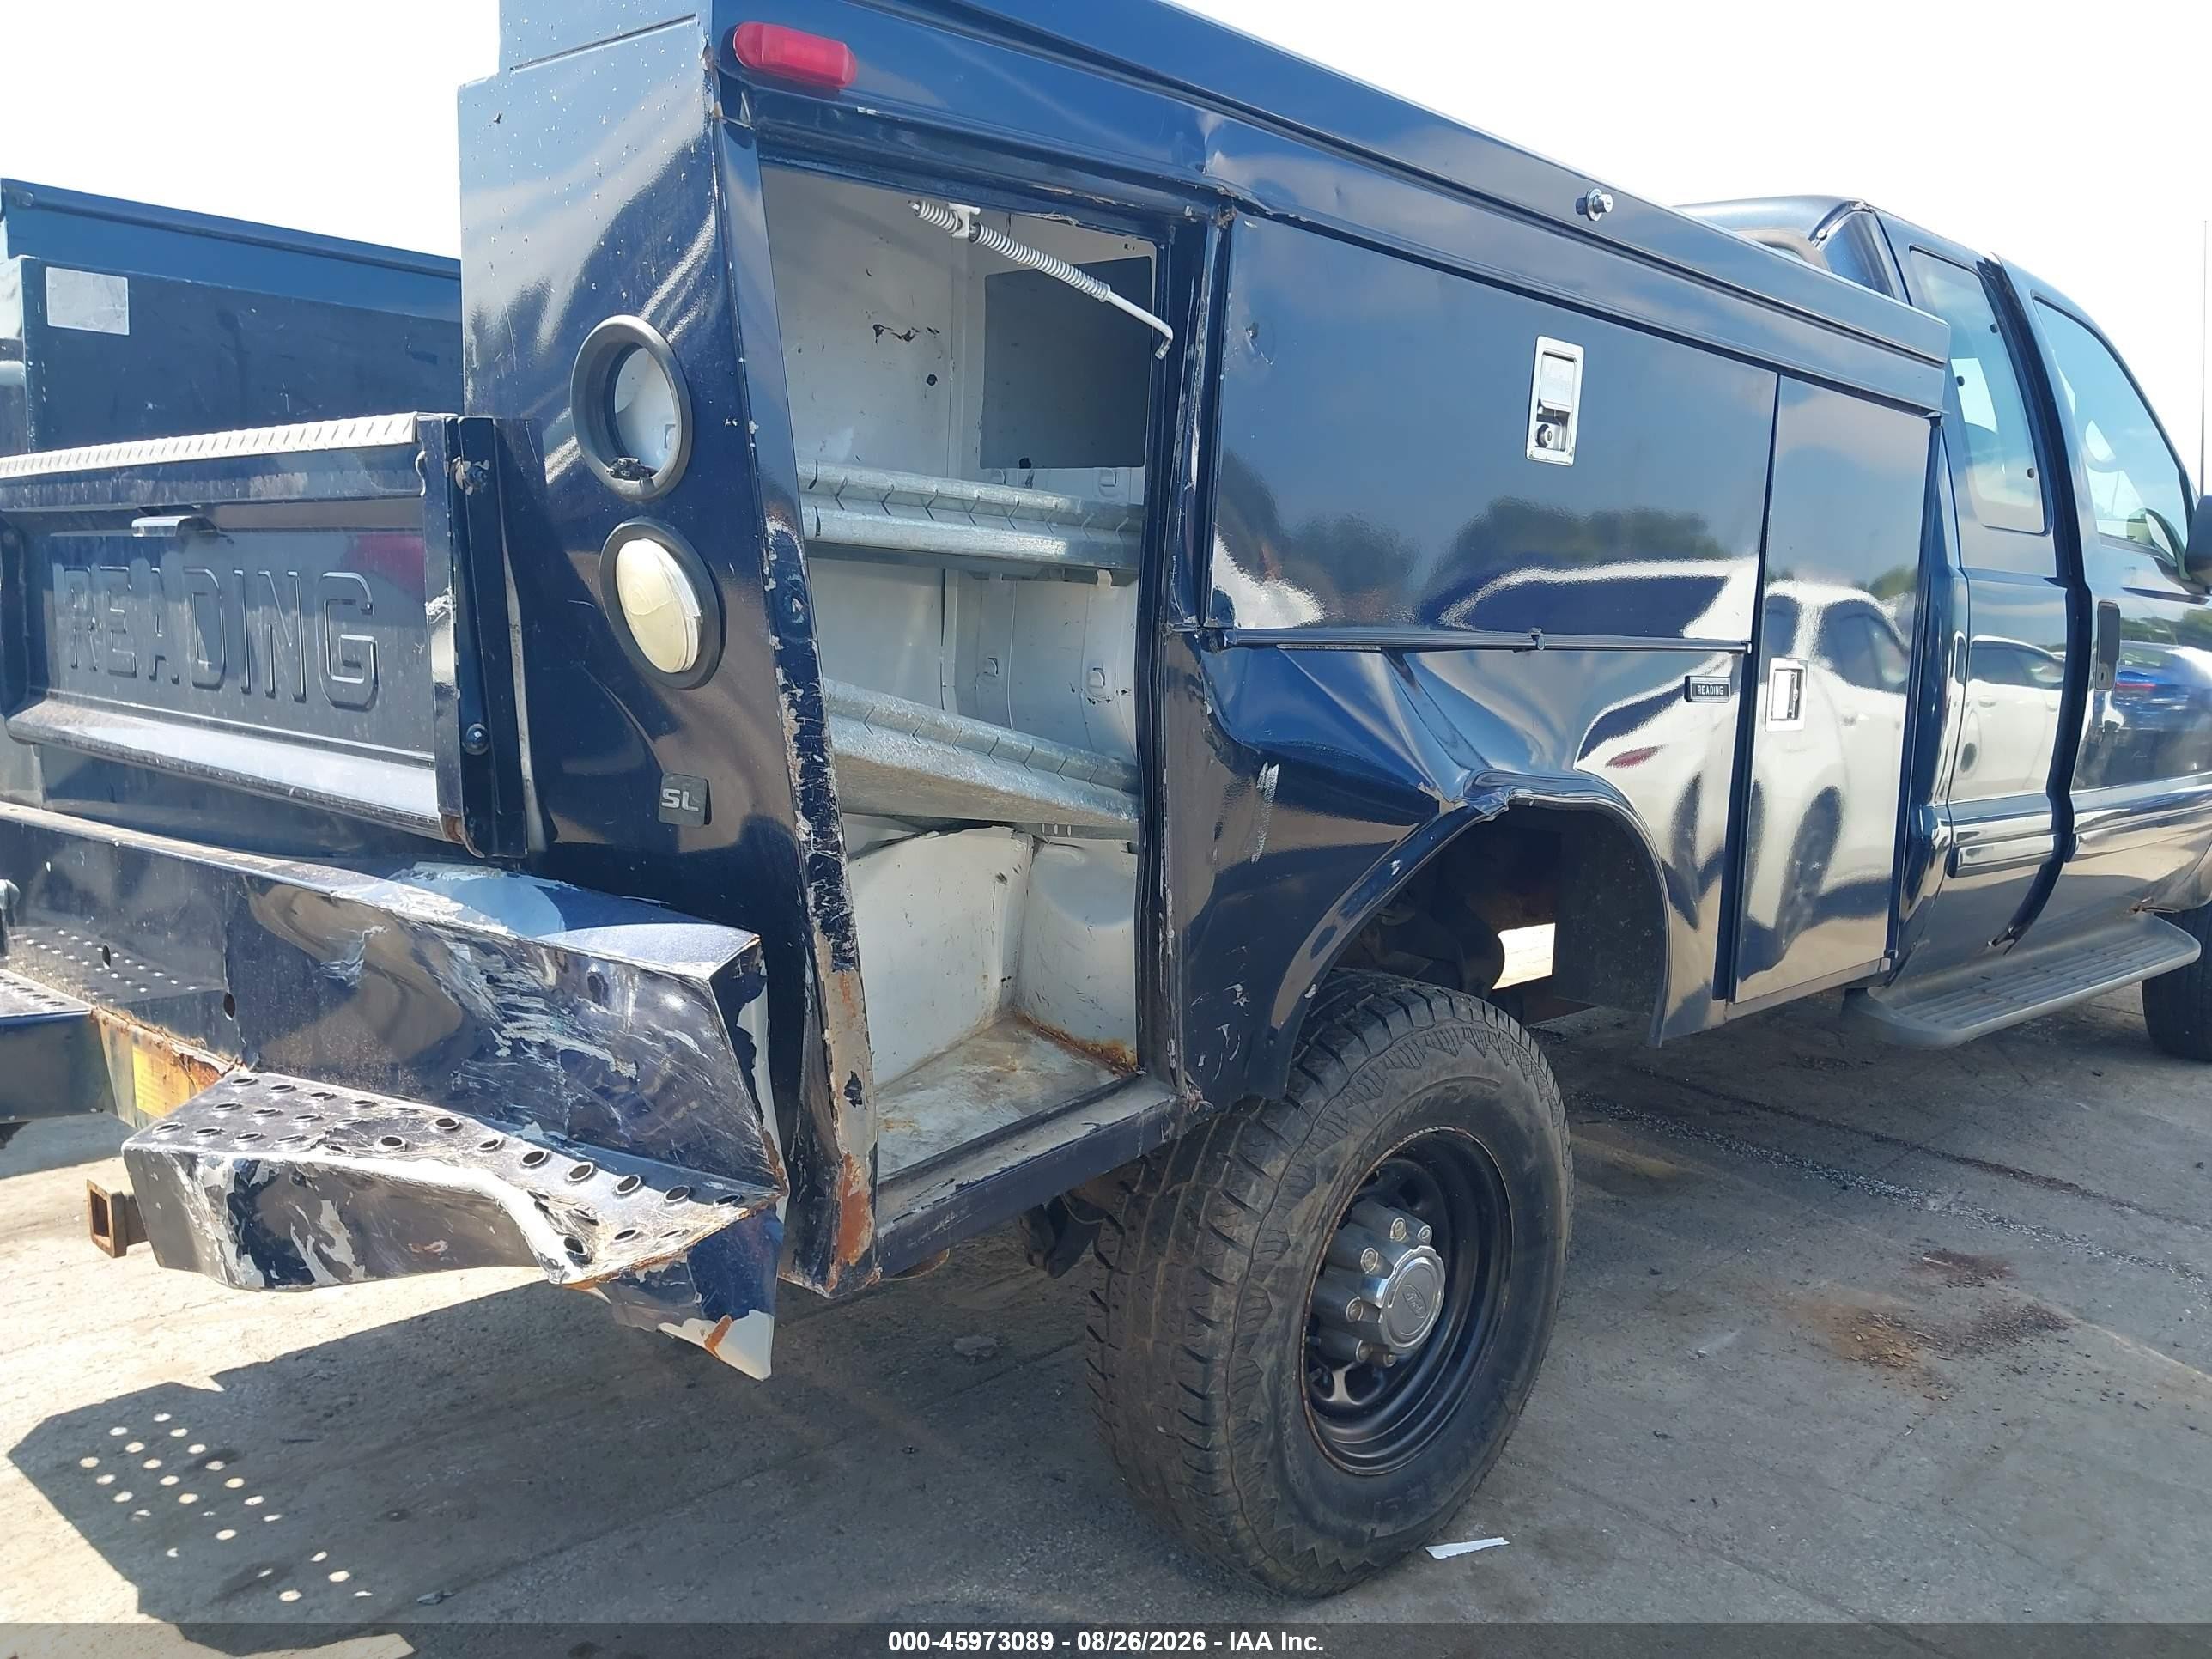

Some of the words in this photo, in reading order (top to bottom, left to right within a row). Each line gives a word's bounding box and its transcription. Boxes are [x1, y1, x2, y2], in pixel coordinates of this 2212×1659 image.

[55, 564, 380, 712] READING
[1697, 684, 1725, 696] READING
[661, 788, 700, 812] SL
